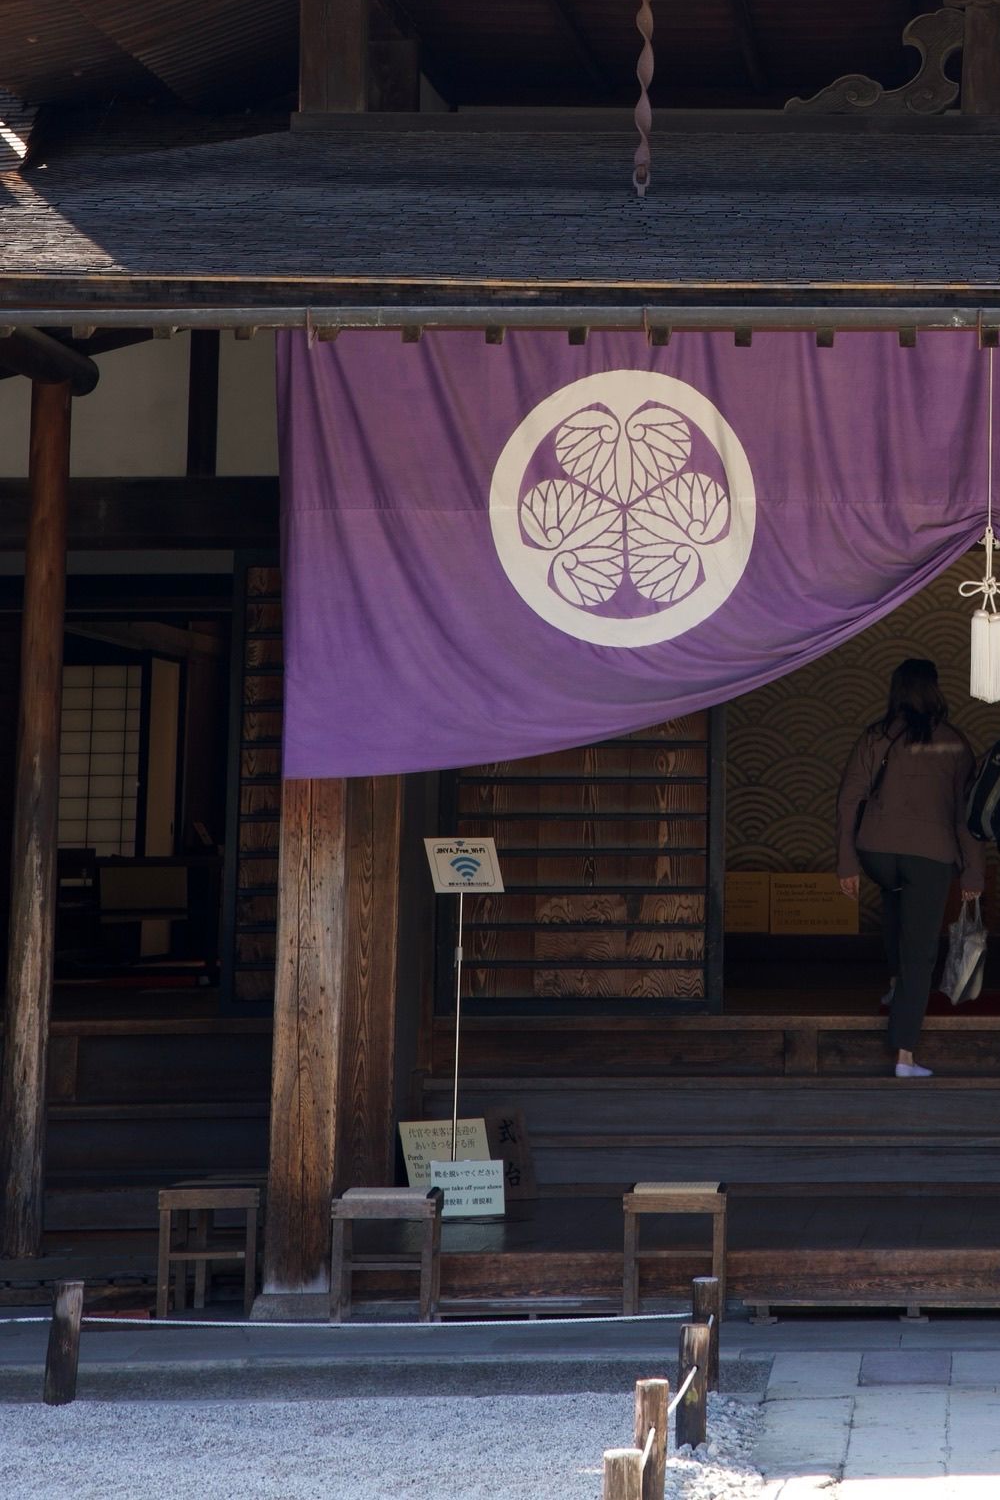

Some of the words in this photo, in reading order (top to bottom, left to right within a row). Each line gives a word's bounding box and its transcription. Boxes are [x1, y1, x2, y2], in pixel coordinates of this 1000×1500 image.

[499, 1119, 521, 1188] 式台
[434, 1169, 500, 1178] 靴を脱いでください
